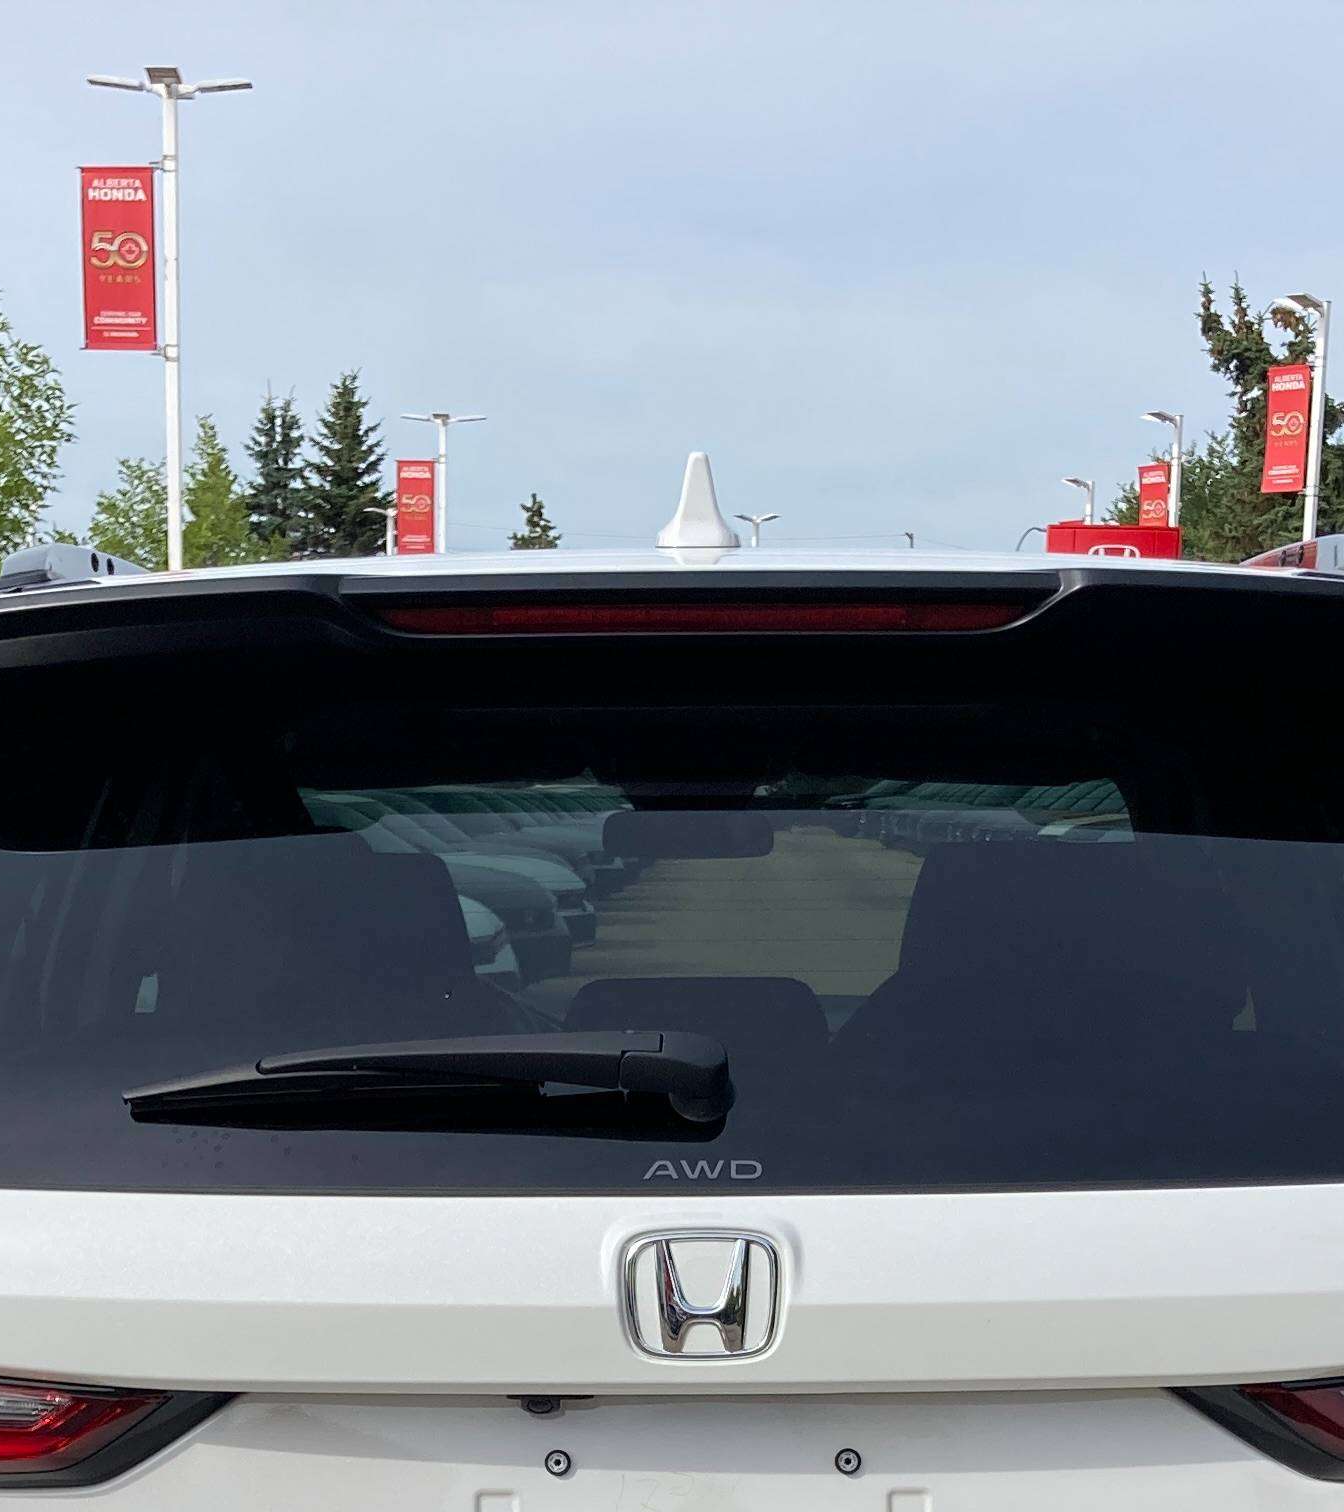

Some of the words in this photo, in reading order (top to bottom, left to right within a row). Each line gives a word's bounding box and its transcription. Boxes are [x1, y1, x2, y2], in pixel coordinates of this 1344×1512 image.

[91, 178, 142, 188] ALBERTA
[87, 188, 147, 201] HONDA
[90, 231, 149, 269] 50
[1271, 380, 1306, 392] HONDA
[1270, 411, 1305, 436] 50
[642, 1159, 764, 1181] AWD
